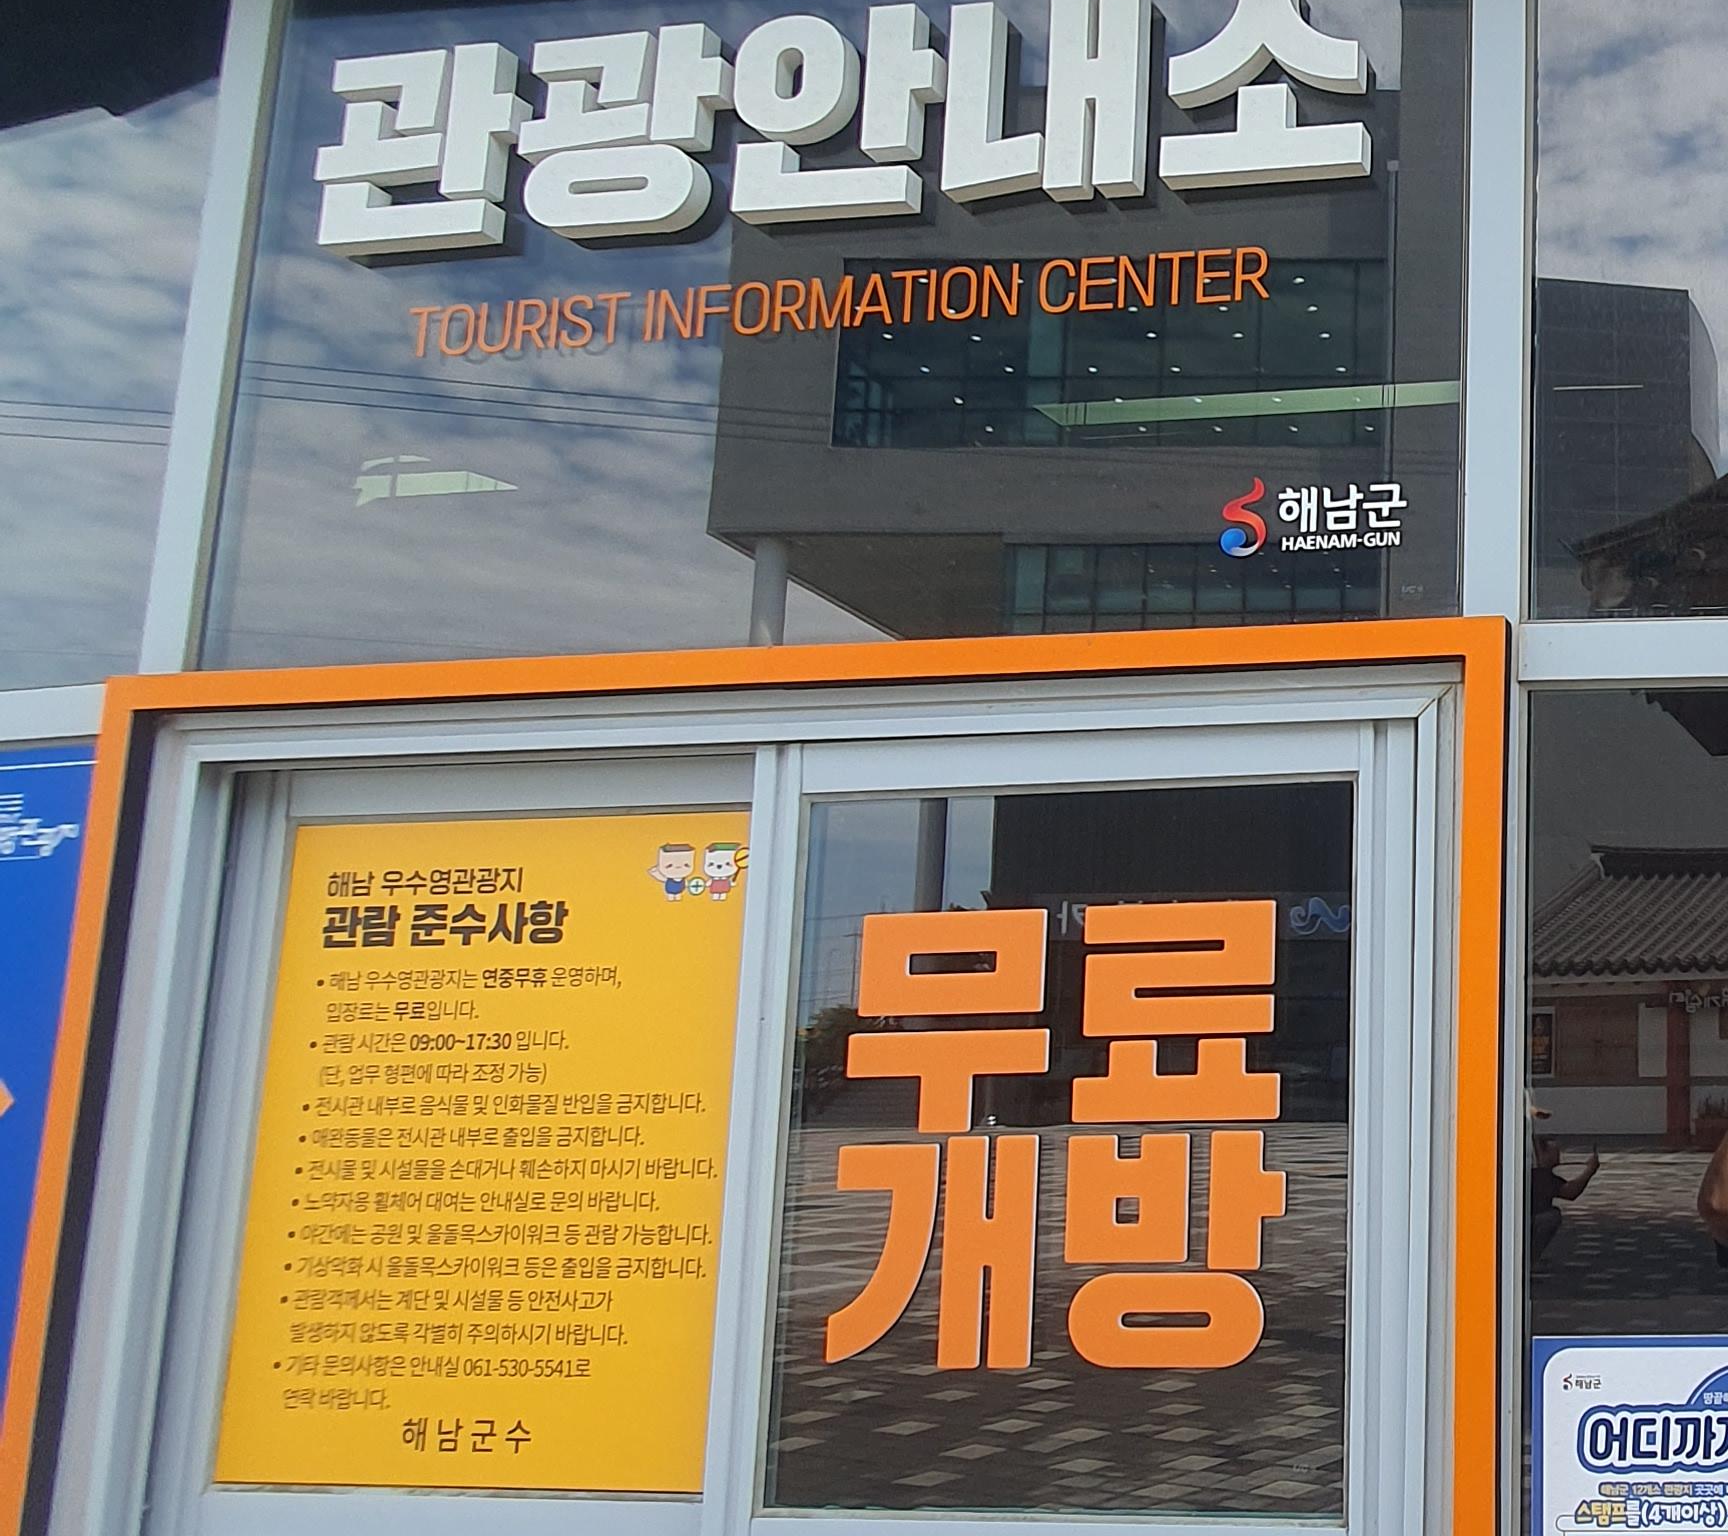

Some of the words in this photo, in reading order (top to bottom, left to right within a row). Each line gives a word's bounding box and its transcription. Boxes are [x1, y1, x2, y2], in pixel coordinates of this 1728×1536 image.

[410, 291, 630, 359] TOURIST
[643, 262, 1020, 344] INFORMATION
[1038, 245, 1270, 315] CENTER
[1278, 483, 1408, 533] 해남군
[1281, 531, 1401, 552] HAENAM-GUN
[327, 871, 374, 898] 해남
[381, 866, 523, 896] 우수영관광지
[323, 905, 400, 948] 관람
[410, 900, 569, 946] 준수사항
[329, 970, 362, 991] 해남
[364, 968, 479, 990] 우수영관광지는
[482, 967, 548, 989] 연중무휴
[551, 965, 622, 988] 운영하며,
[393, 1000, 480, 1021] 무료입니다.
[846, 899, 1280, 1133] 무료
[322, 1034, 354, 1054] 관람
[357, 1033, 406, 1053] 시간은
[409, 1032, 512, 1052] 09:00~17:30
[516, 1030, 570, 1051] 입니다.
[319, 1066, 345, 1087] (단,
[349, 1065, 381, 1085] 업무
[384, 1064, 432, 1085] 형편에
[436, 1063, 469, 1083] 따라
[472, 1063, 505, 1083] 조정
[508, 1062, 547, 1085] 가능)
[314, 1096, 365, 1117] 전시관
[367, 1095, 416, 1115] 내부로
[419, 1094, 469, 1115] 음식물
[473, 1094, 489, 1115] 및
[492, 1093, 559, 1115] 인화물질
[562, 1092, 613, 1115] 반입을
[616, 1092, 707, 1114] 금지합니다.
[312, 1127, 394, 1149] 애완동물은
[397, 1127, 446, 1148] 전시관
[450, 1127, 500, 1148] 내부로
[503, 1126, 552, 1148] 출입을
[556, 1125, 645, 1148] 금지합니다.
[362, 1159, 377, 1180] 및
[379, 1159, 446, 1180] 시설물을
[450, 1158, 515, 1180] 손대거나
[519, 1158, 586, 1180] 훼손하지
[590, 1158, 641, 1180] 마시기
[645, 1157, 718, 1179] 바랍니다.
[373, 1191, 423, 1213] 휠체어
[426, 1191, 476, 1213] 대여는
[480, 1190, 547, 1212] 안내실로
[550, 1190, 584, 1212] 문의
[588, 1190, 660, 1212] 바랍니다.
[301, 1223, 368, 1245] 야간에는
[370, 1223, 404, 1245] 공원
[407, 1223, 423, 1245] 및
[427, 1223, 560, 1245] 울돌목스카이워크
[563, 1224, 580, 1246] 등
[584, 1224, 620, 1246] 관람
[622, 1223, 713, 1246] 가능합니다.
[826, 1130, 1287, 1369] 개방
[366, 1255, 384, 1278] 시
[387, 1255, 520, 1278] 울돌목스카이워크
[524, 1257, 558, 1279] 등은
[561, 1257, 612, 1279] 출입을
[616, 1256, 707, 1279] 금지합니다.
[396, 1289, 430, 1311] 계단
[434, 1289, 449, 1311] 및
[453, 1289, 504, 1311] 시설물
[507, 1290, 525, 1312] 등
[528, 1289, 614, 1312] 안전사고가
[290, 1322, 357, 1344] 발생하지
[360, 1322, 410, 1344] 않도록
[412, 1322, 463, 1345] 각별히
[467, 1323, 552, 1345] 주의하시기
[555, 1323, 629, 1346] 바랍니다.
[285, 1355, 321, 1377] 기타
[322, 1354, 406, 1377] 문의사항은
[409, 1355, 461, 1378] 안내실
[463, 1358, 592, 1379] 061-530-5541로
[319, 1388, 391, 1410] 바랍니다.
